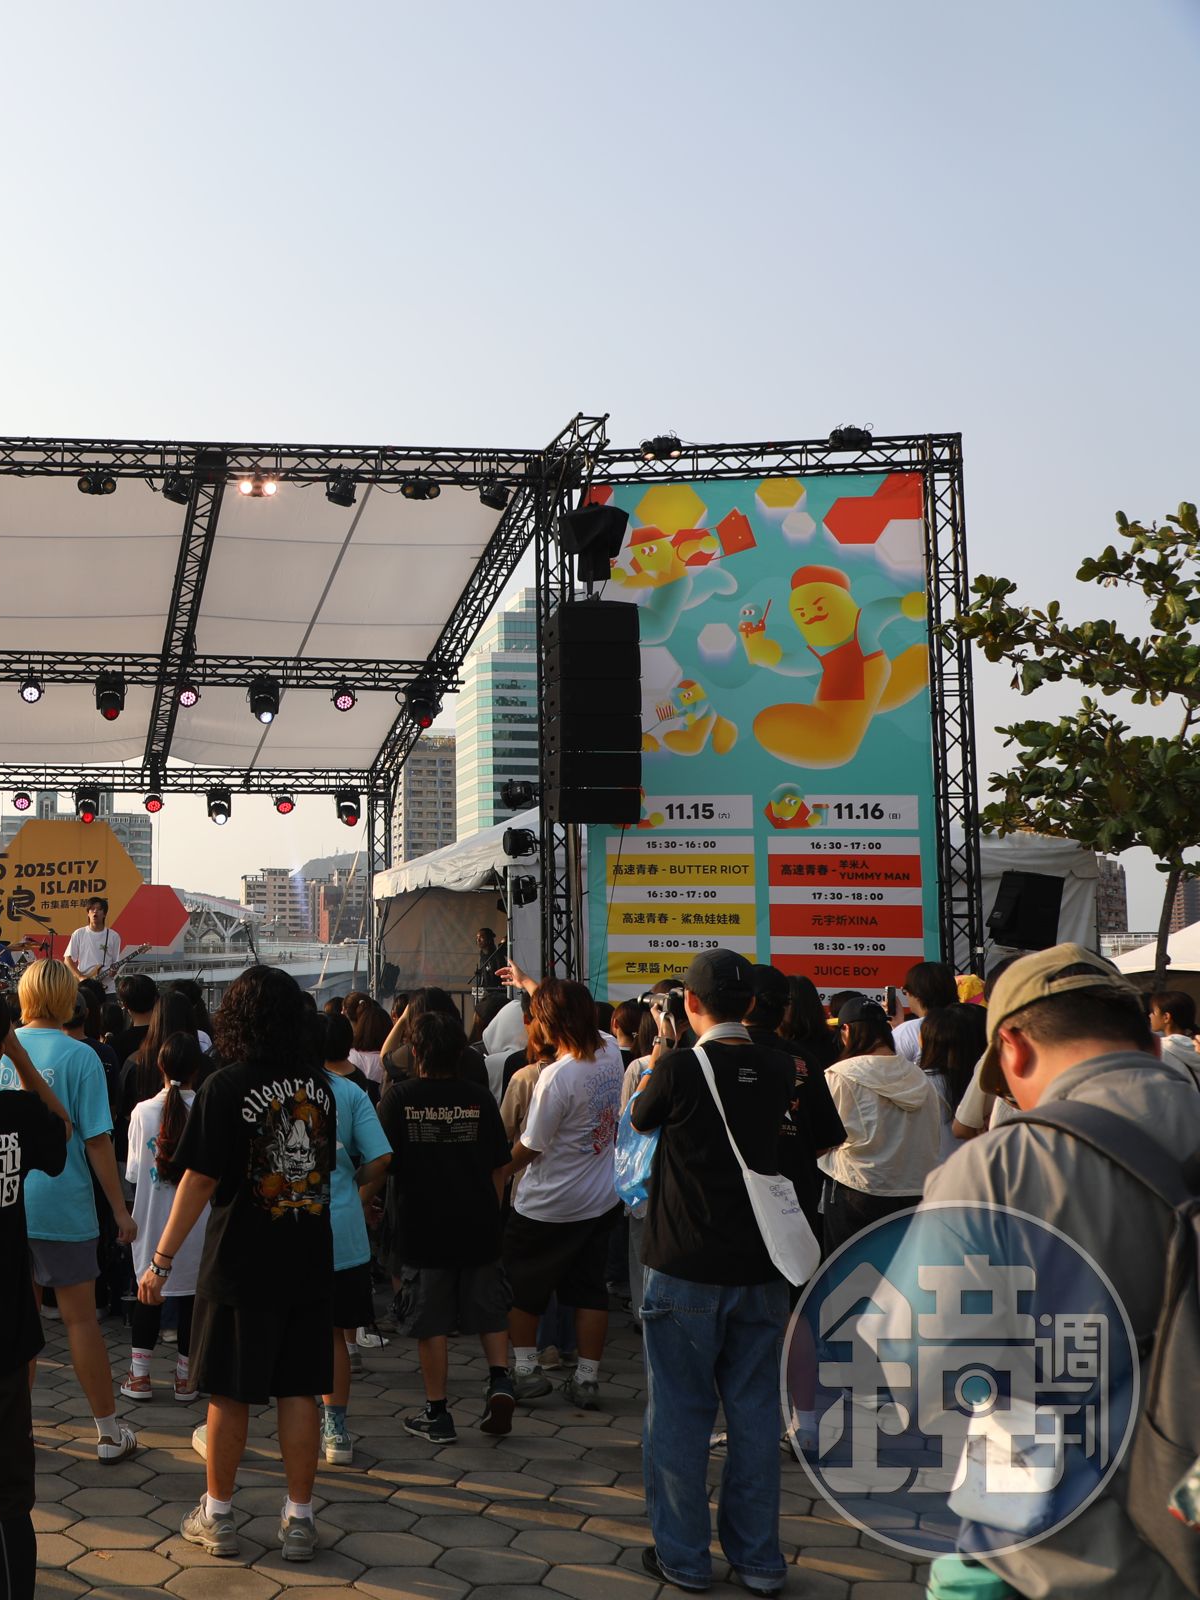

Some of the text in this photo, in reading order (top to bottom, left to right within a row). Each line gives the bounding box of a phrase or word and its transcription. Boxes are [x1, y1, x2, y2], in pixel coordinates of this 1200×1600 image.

[665, 803, 715, 820] 11.15
[833, 803, 885, 820] 11.16
[612, 864, 659, 876] 高速青春
[669, 865, 717, 875] BUTTER
[720, 864, 749, 875] RIOT
[781, 864, 829, 876] 高速青春
[839, 872, 910, 881] YUMMY MAN
[40, 878, 107, 895] ISLAND
[622, 913, 669, 924] 高速青春
[625, 962, 660, 974] 芒果醬
[813, 966, 879, 977] JUICE BOY
[241, 1077, 330, 1123] ellegarden
[404, 1106, 480, 1124] Tiny Me Big Dream
